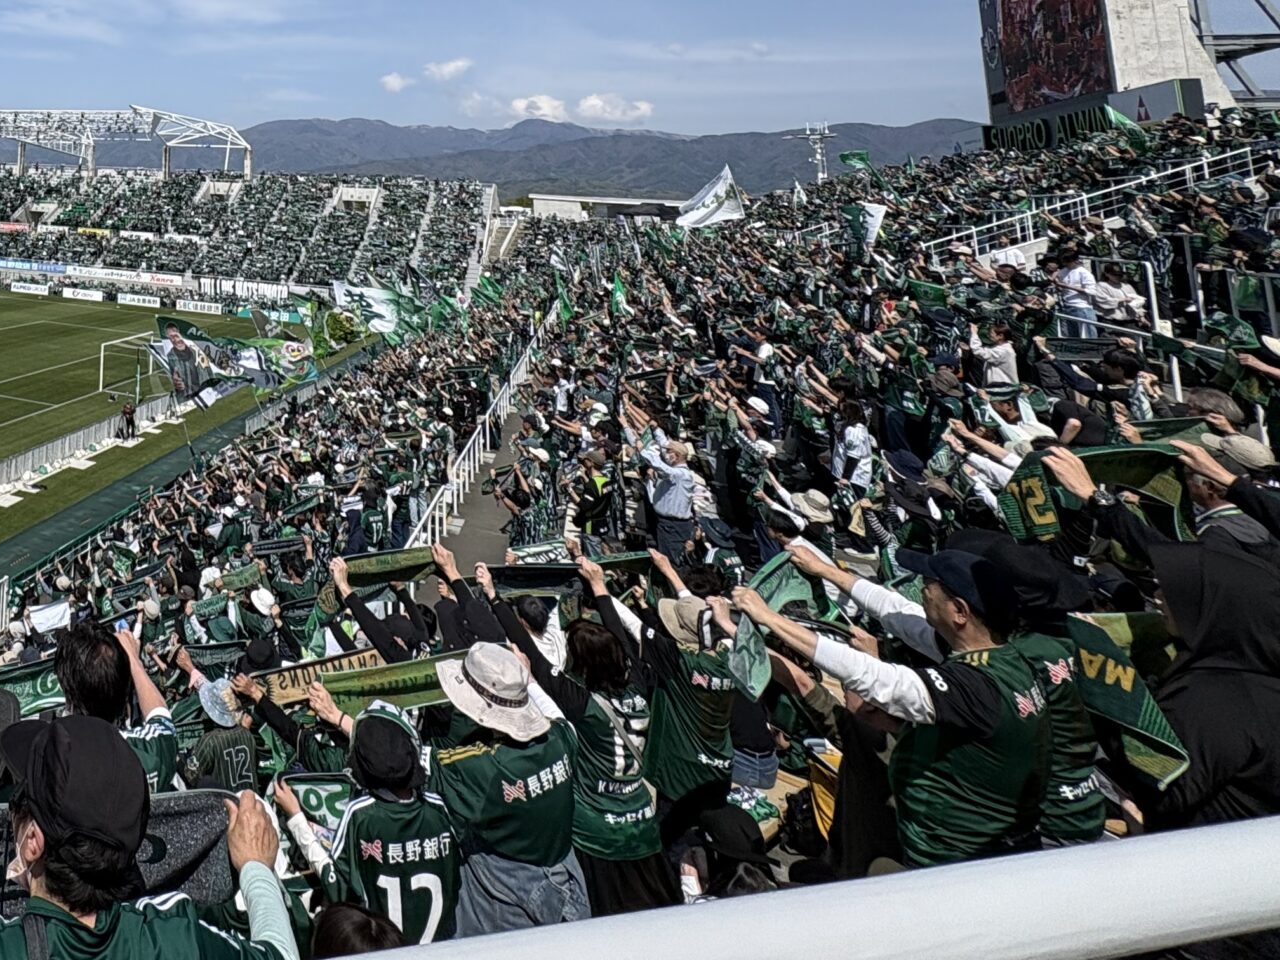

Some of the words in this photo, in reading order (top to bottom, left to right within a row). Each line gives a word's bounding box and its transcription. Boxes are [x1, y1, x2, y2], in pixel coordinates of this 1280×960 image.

[1006, 475, 1057, 528] 12
[222, 745, 254, 787] 12
[387, 832, 451, 864] 長野銀行
